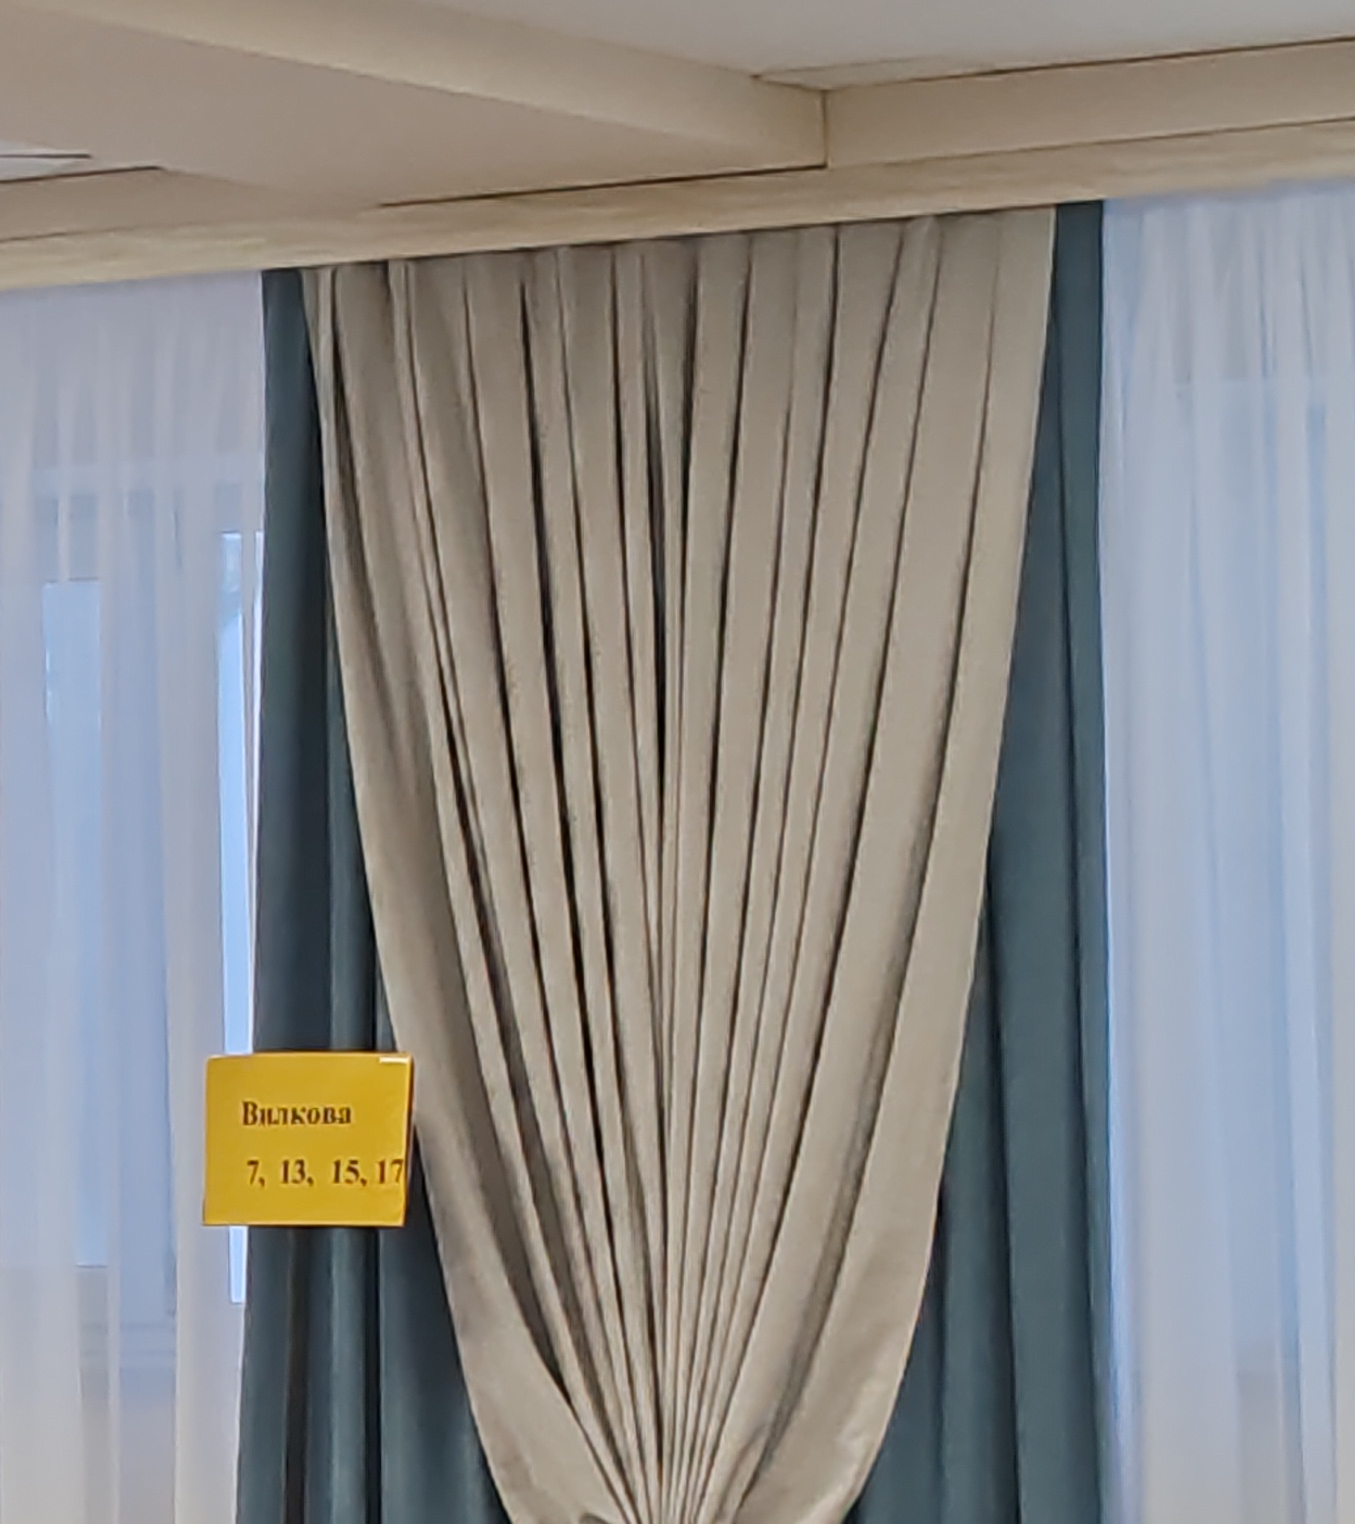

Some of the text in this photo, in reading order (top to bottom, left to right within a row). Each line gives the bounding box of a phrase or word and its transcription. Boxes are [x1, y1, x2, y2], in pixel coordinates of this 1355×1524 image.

[242, 1101, 351, 1126] Вилкова
[246, 1158, 404, 1187] 7, 13, 15, 17
